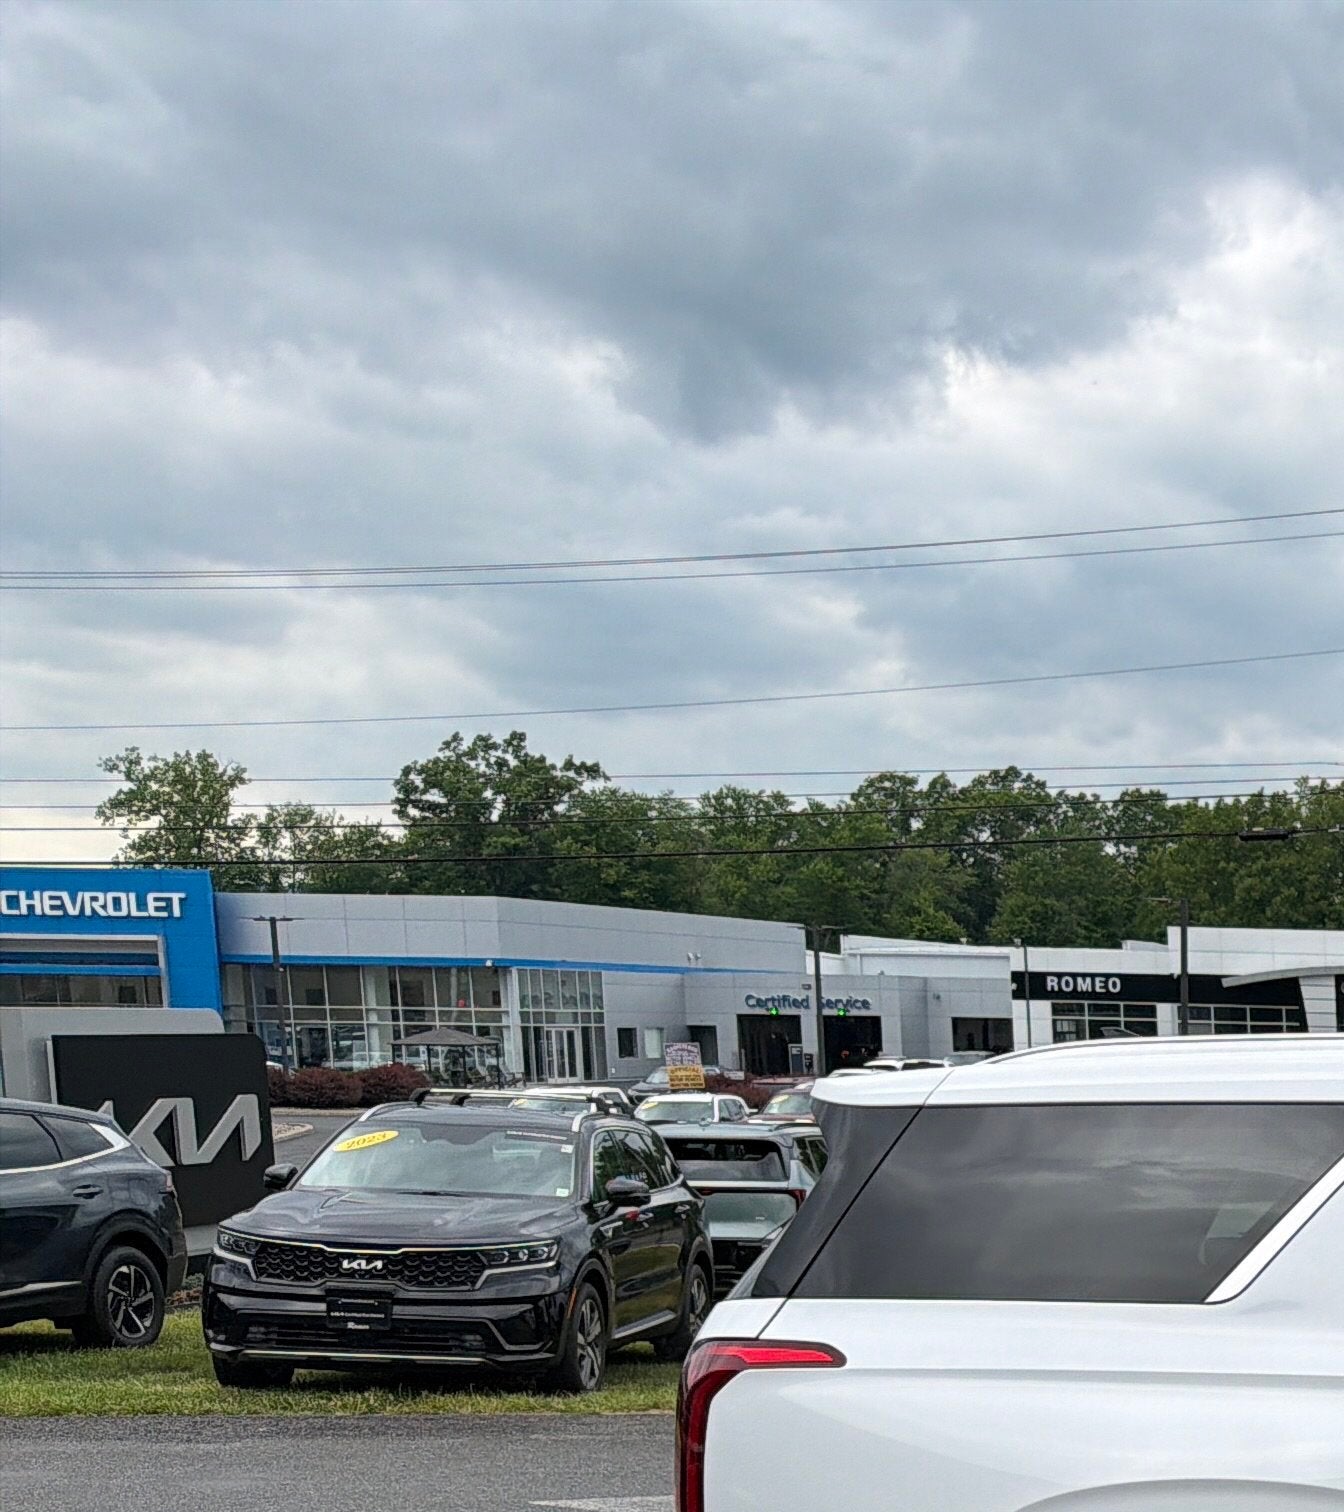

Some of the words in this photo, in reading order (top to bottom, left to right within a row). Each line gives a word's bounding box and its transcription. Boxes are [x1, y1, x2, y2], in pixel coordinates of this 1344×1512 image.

[0, 890, 187, 918] CHEVROLET
[1046, 975, 1121, 993] ROMEO
[744, 994, 810, 1010] Certified
[342, 1259, 383, 1270] KIA
